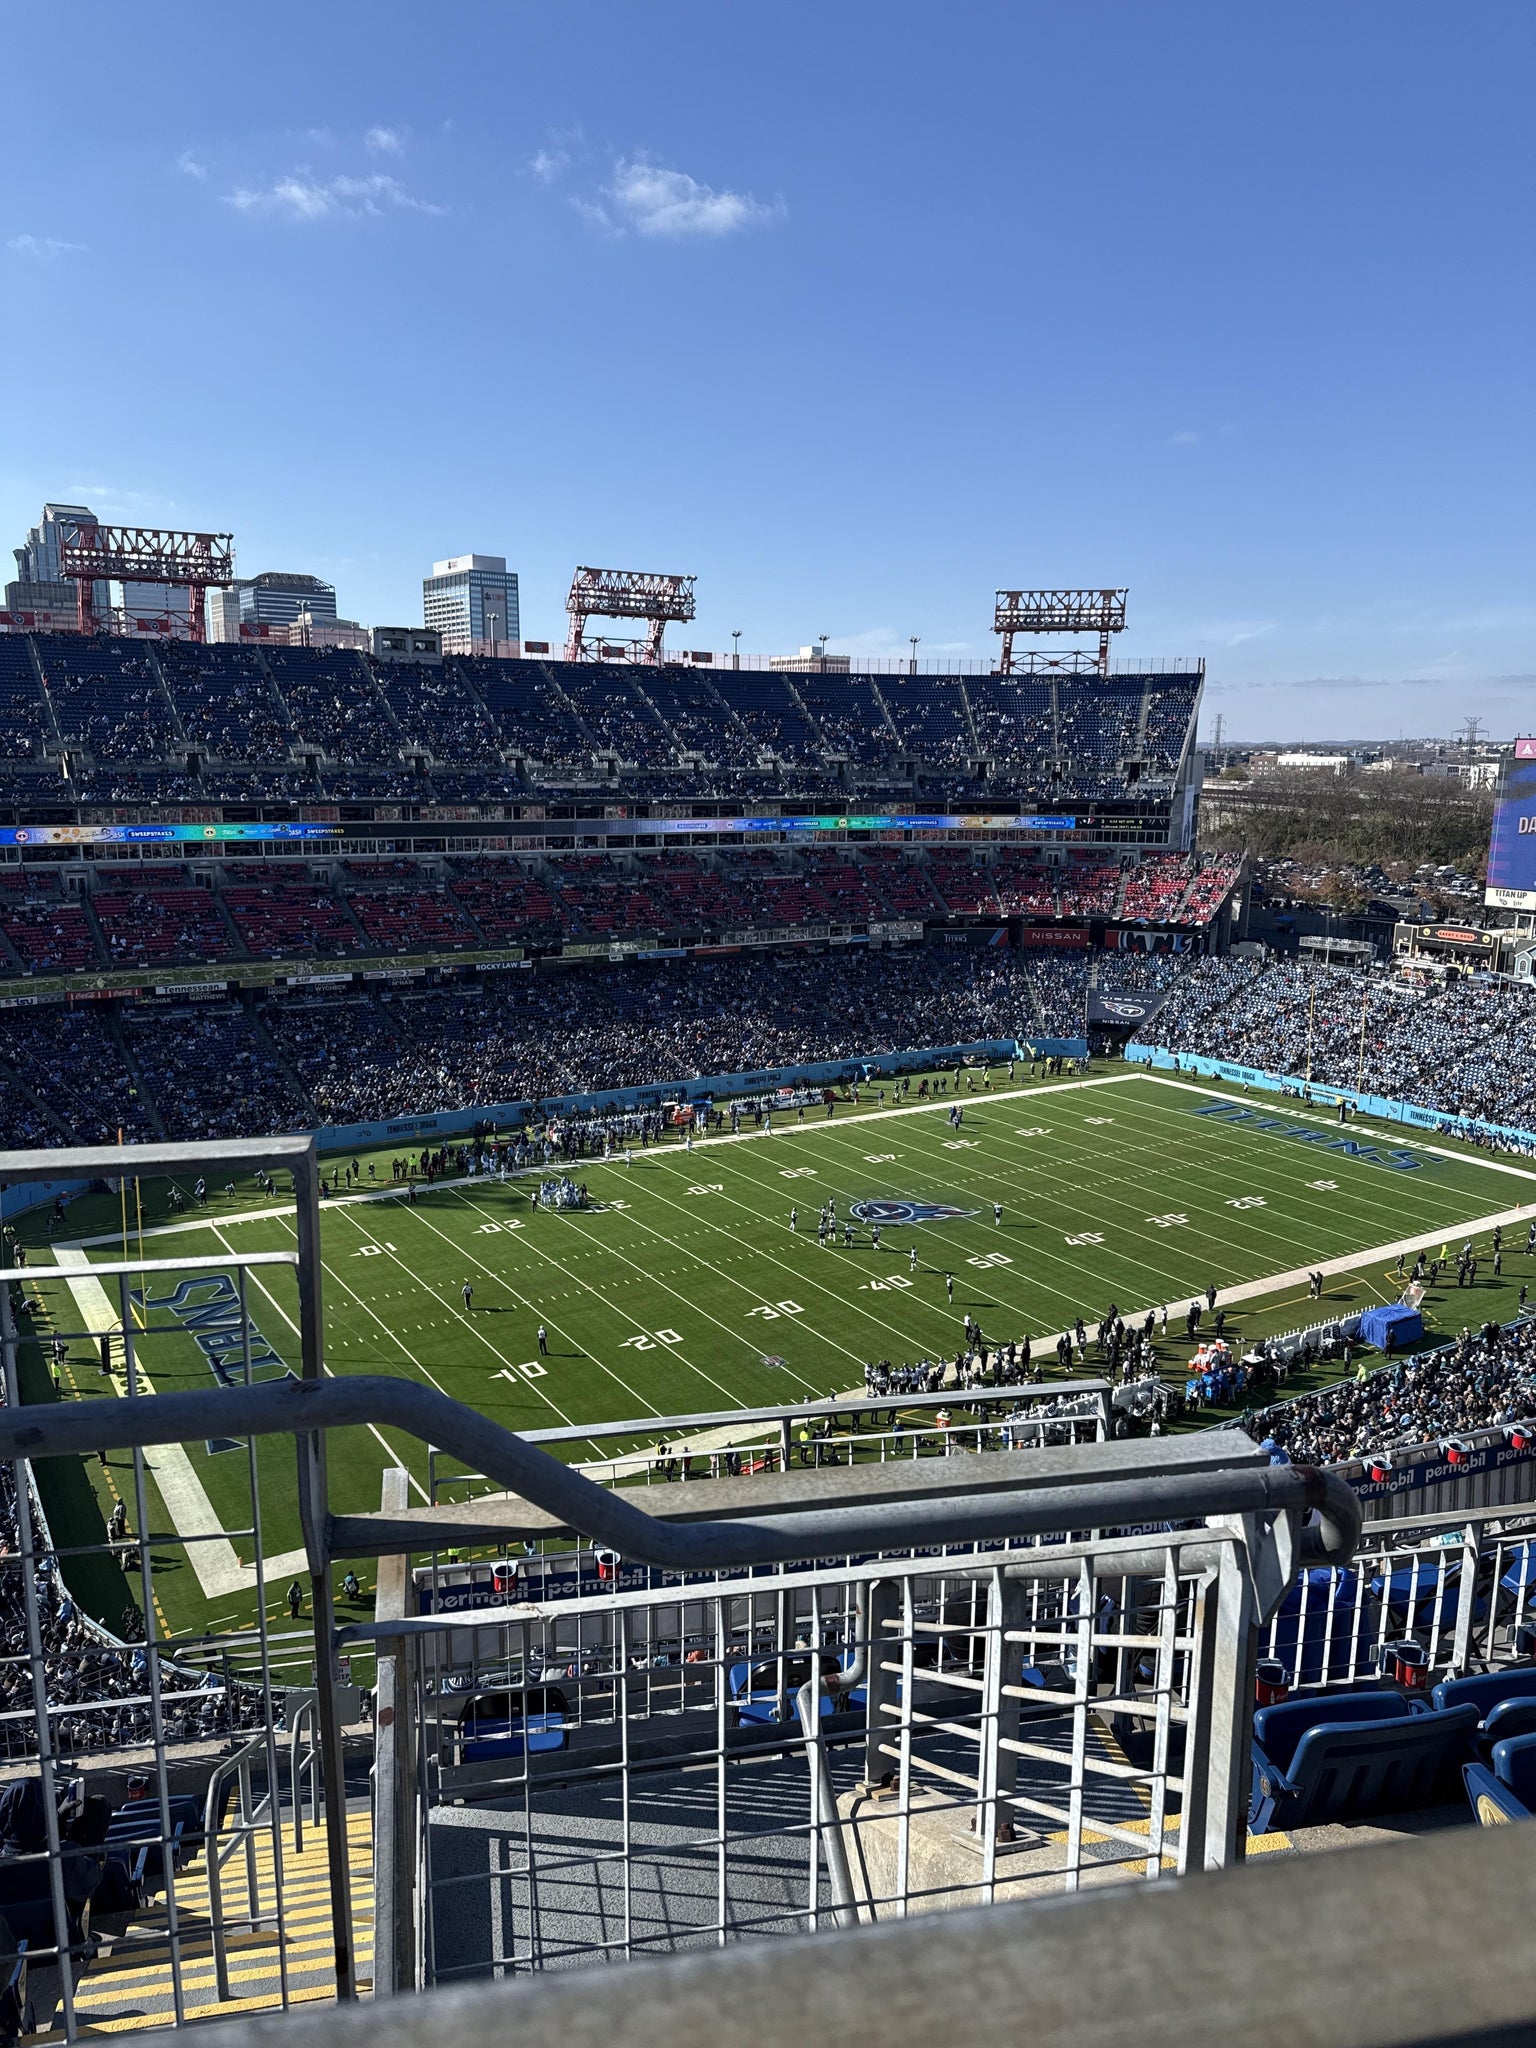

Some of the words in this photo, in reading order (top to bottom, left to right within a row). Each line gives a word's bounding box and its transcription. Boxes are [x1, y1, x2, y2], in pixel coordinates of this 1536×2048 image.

[1495, 890, 1516, 898] TITAN
[943, 933, 968, 943] TITANS
[1031, 931, 1081, 941] NISSAN
[440, 966, 459, 974] FedEx
[476, 963, 501, 971] ROCKY
[1219, 1066, 1241, 1078] TENNESSEE
[1242, 1071, 1256, 1081] TOUGH
[1410, 1110, 1437, 1124] TENNESSEE
[1014, 1127, 1053, 1138] 20
[1188, 1098, 1446, 1171] TITANS
[778, 1167, 819, 1179] 50
[688, 1183, 724, 1195] 40
[1304, 1180, 1340, 1192] 10
[1225, 1196, 1268, 1210] 20
[481, 1219, 525, 1234] 20
[1145, 1213, 1189, 1228] 30
[1064, 1231, 1106, 1246] 40
[360, 1242, 397, 1256] 10
[965, 1252, 1014, 1270] 50
[870, 1274, 914, 1291] 40
[756, 1300, 805, 1320] 30
[627, 1328, 684, 1350] 20
[501, 1360, 549, 1383] 10
[1425, 1452, 1486, 1484] permobil
[548, 1567, 644, 1600] permobil
[430, 1581, 529, 1611] permobil
